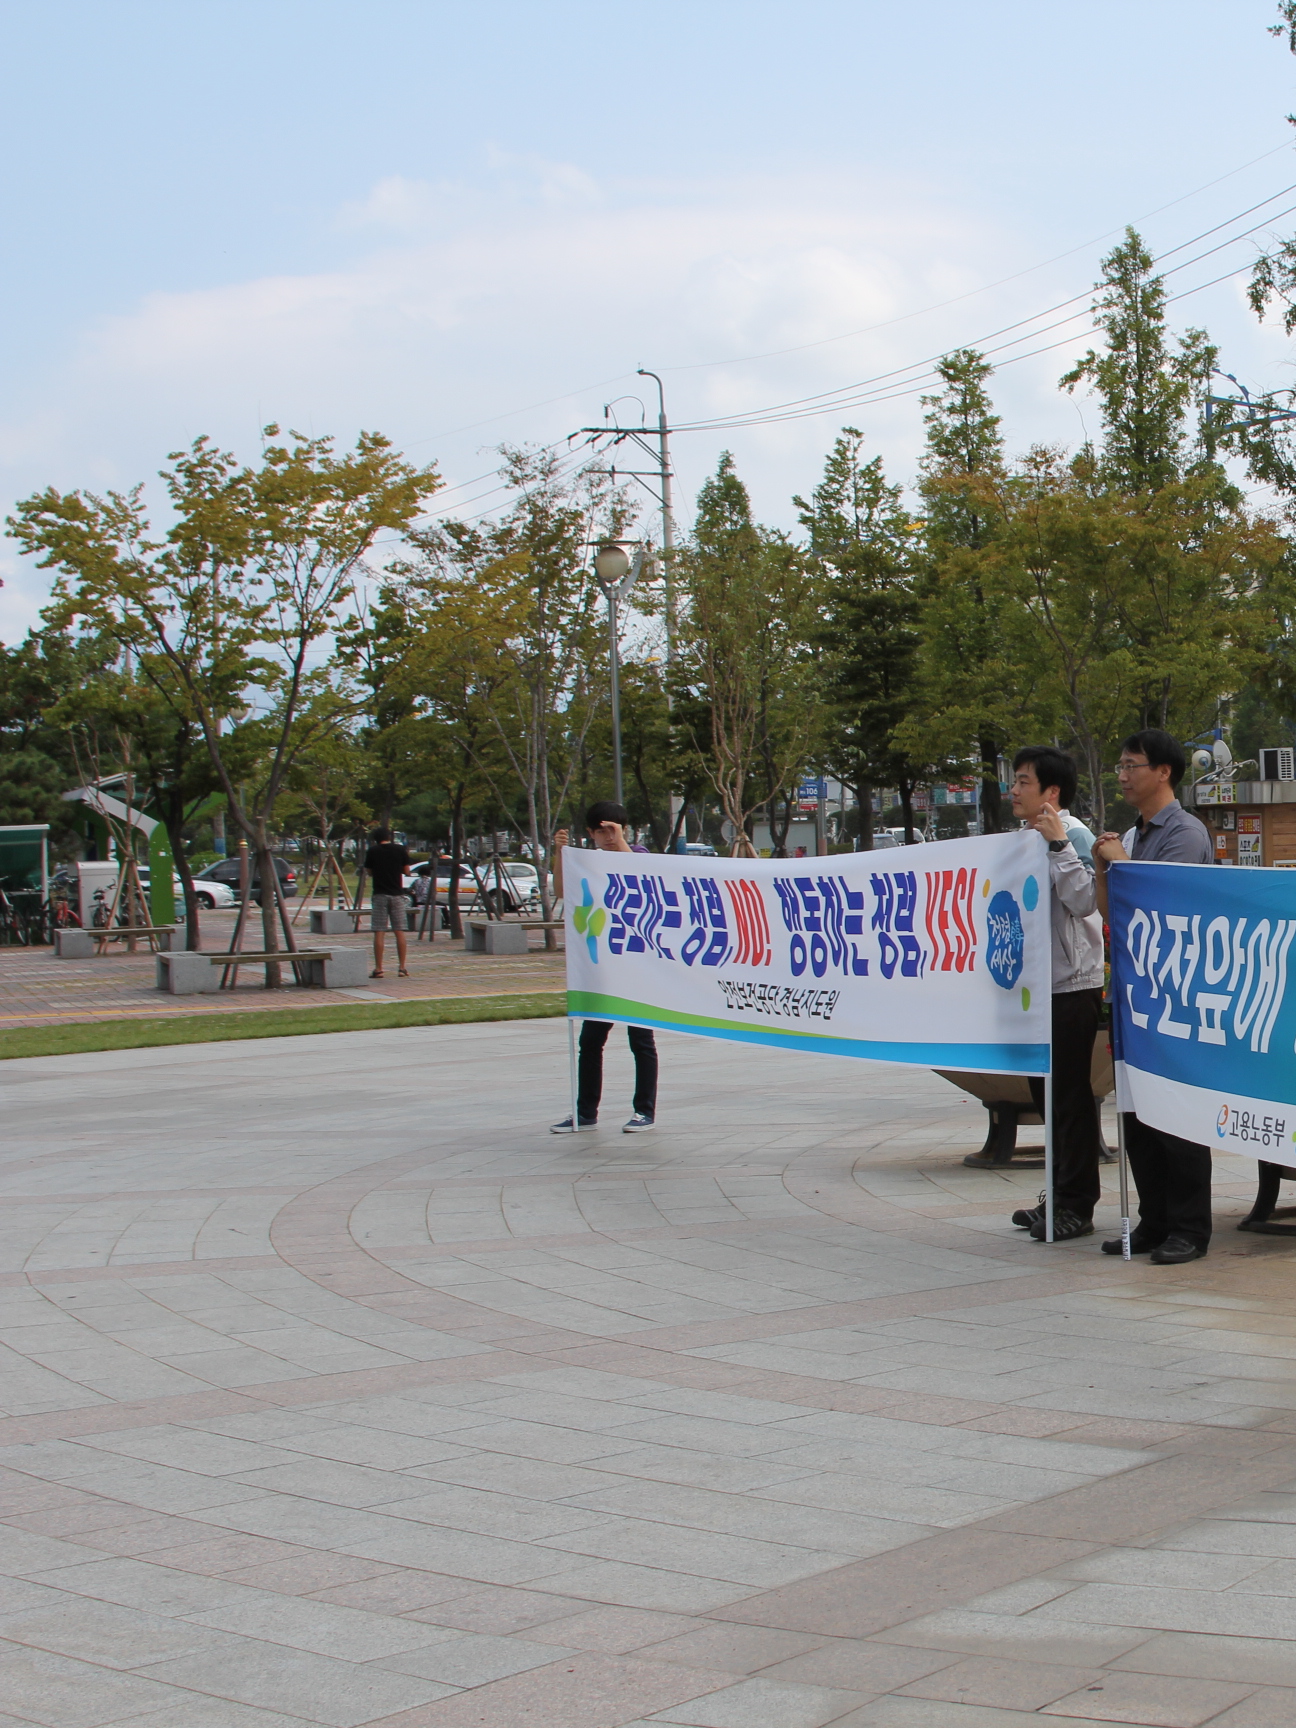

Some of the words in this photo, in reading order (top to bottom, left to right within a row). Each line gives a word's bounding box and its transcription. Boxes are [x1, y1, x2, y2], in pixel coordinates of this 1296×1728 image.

[806, 787, 818, 795] 106
[724, 878, 772, 967] NO!
[773, 876, 869, 978] 행동하는
[925, 867, 978, 973] YES!
[717, 979, 782, 1015] 안전보건공단
[779, 985, 841, 1020] 경남지도원
[1126, 908, 1296, 1054] 안전앞에
[1229, 1109, 1286, 1148] 고용노동부
